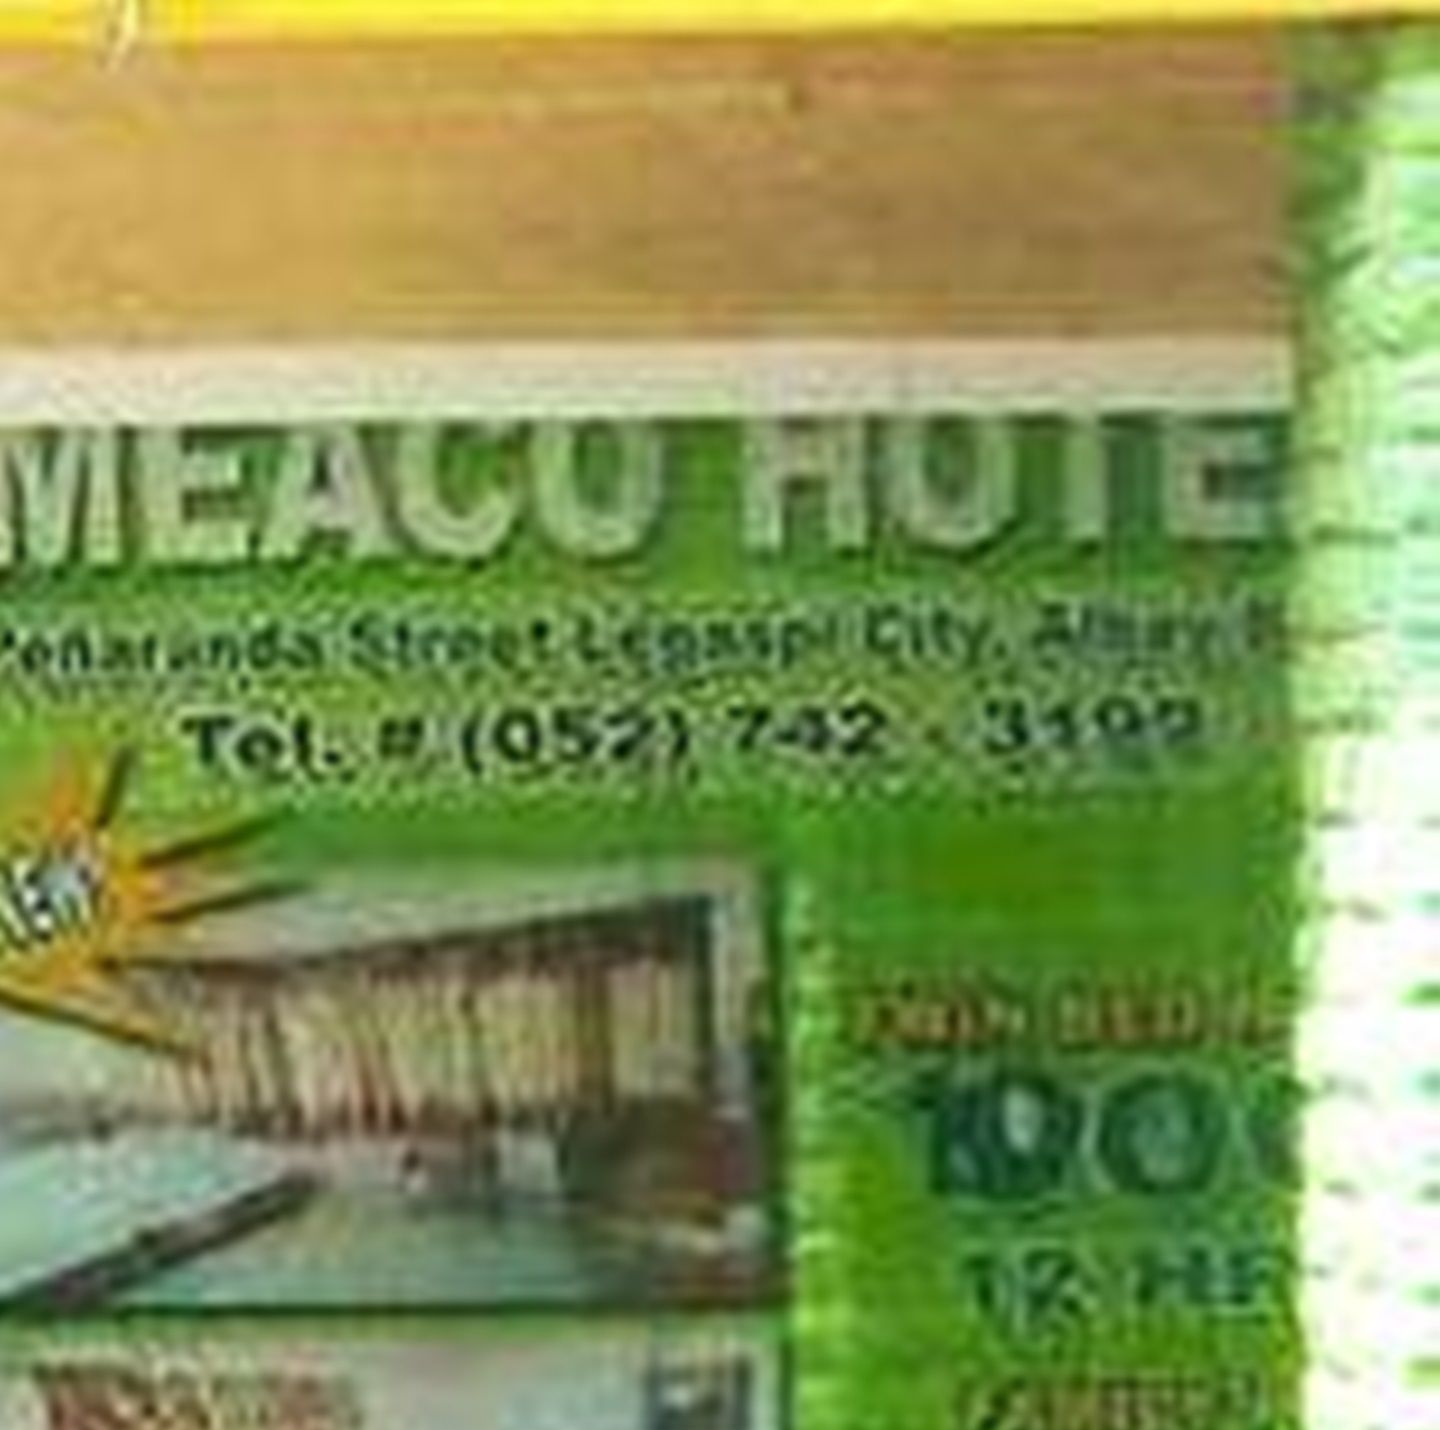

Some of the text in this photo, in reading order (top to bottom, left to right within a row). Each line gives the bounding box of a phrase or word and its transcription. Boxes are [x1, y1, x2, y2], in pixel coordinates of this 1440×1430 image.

[346, 612, 552, 672] Street
[178, 712, 348, 770] Tel.
[458, 702, 694, 778] (052)
